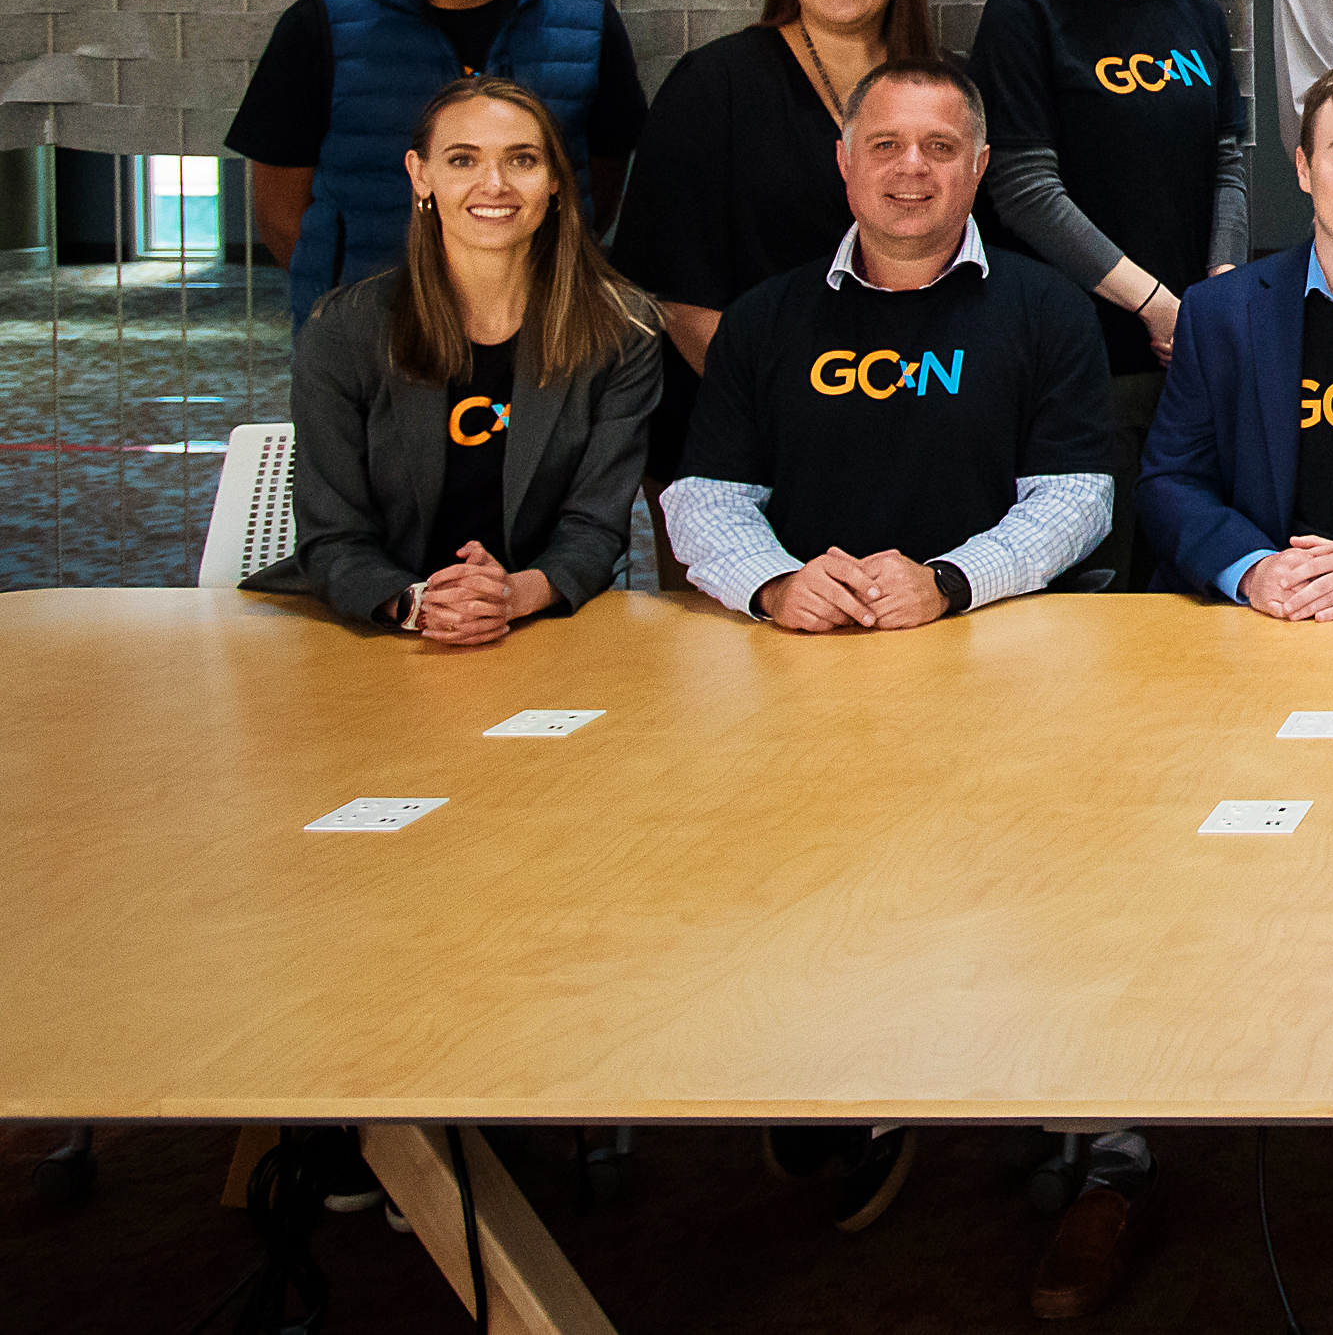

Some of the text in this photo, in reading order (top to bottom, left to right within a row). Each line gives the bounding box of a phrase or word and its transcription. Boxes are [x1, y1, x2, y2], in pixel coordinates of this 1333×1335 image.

[1094, 49, 1212, 95] GCxN
[809, 349, 964, 400] GCxN
[448, 396, 511, 447] Cx
